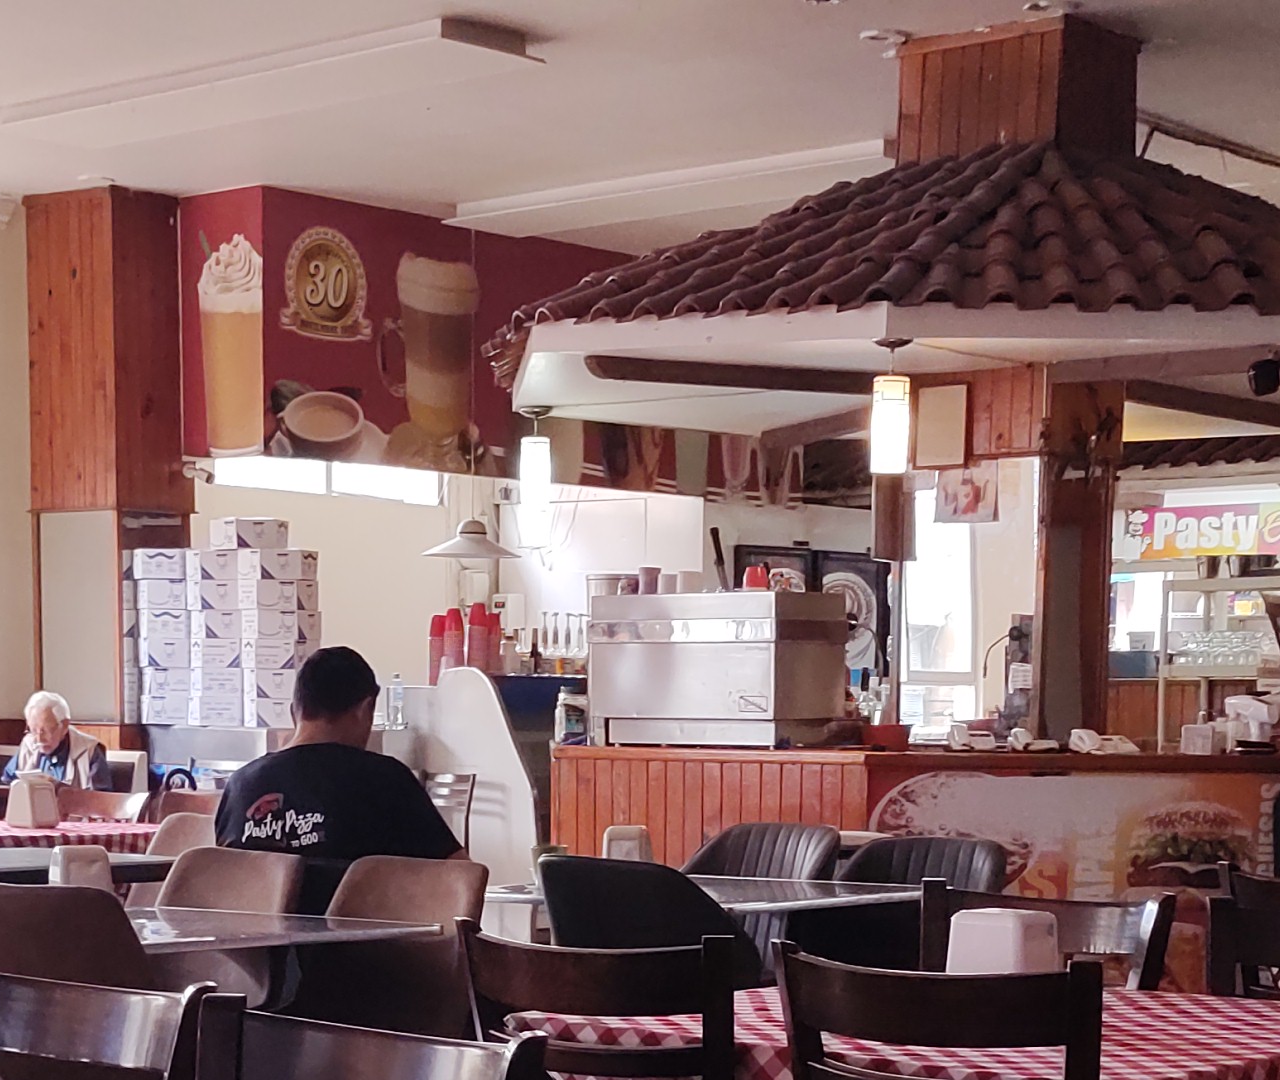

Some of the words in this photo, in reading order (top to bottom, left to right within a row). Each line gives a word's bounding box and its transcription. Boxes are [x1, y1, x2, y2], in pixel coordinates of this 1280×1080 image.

[306, 261, 349, 307] 30
[1153, 511, 1258, 552] Pasty
[242, 813, 284, 843] Pasty
[285, 809, 325, 834] Pizza
